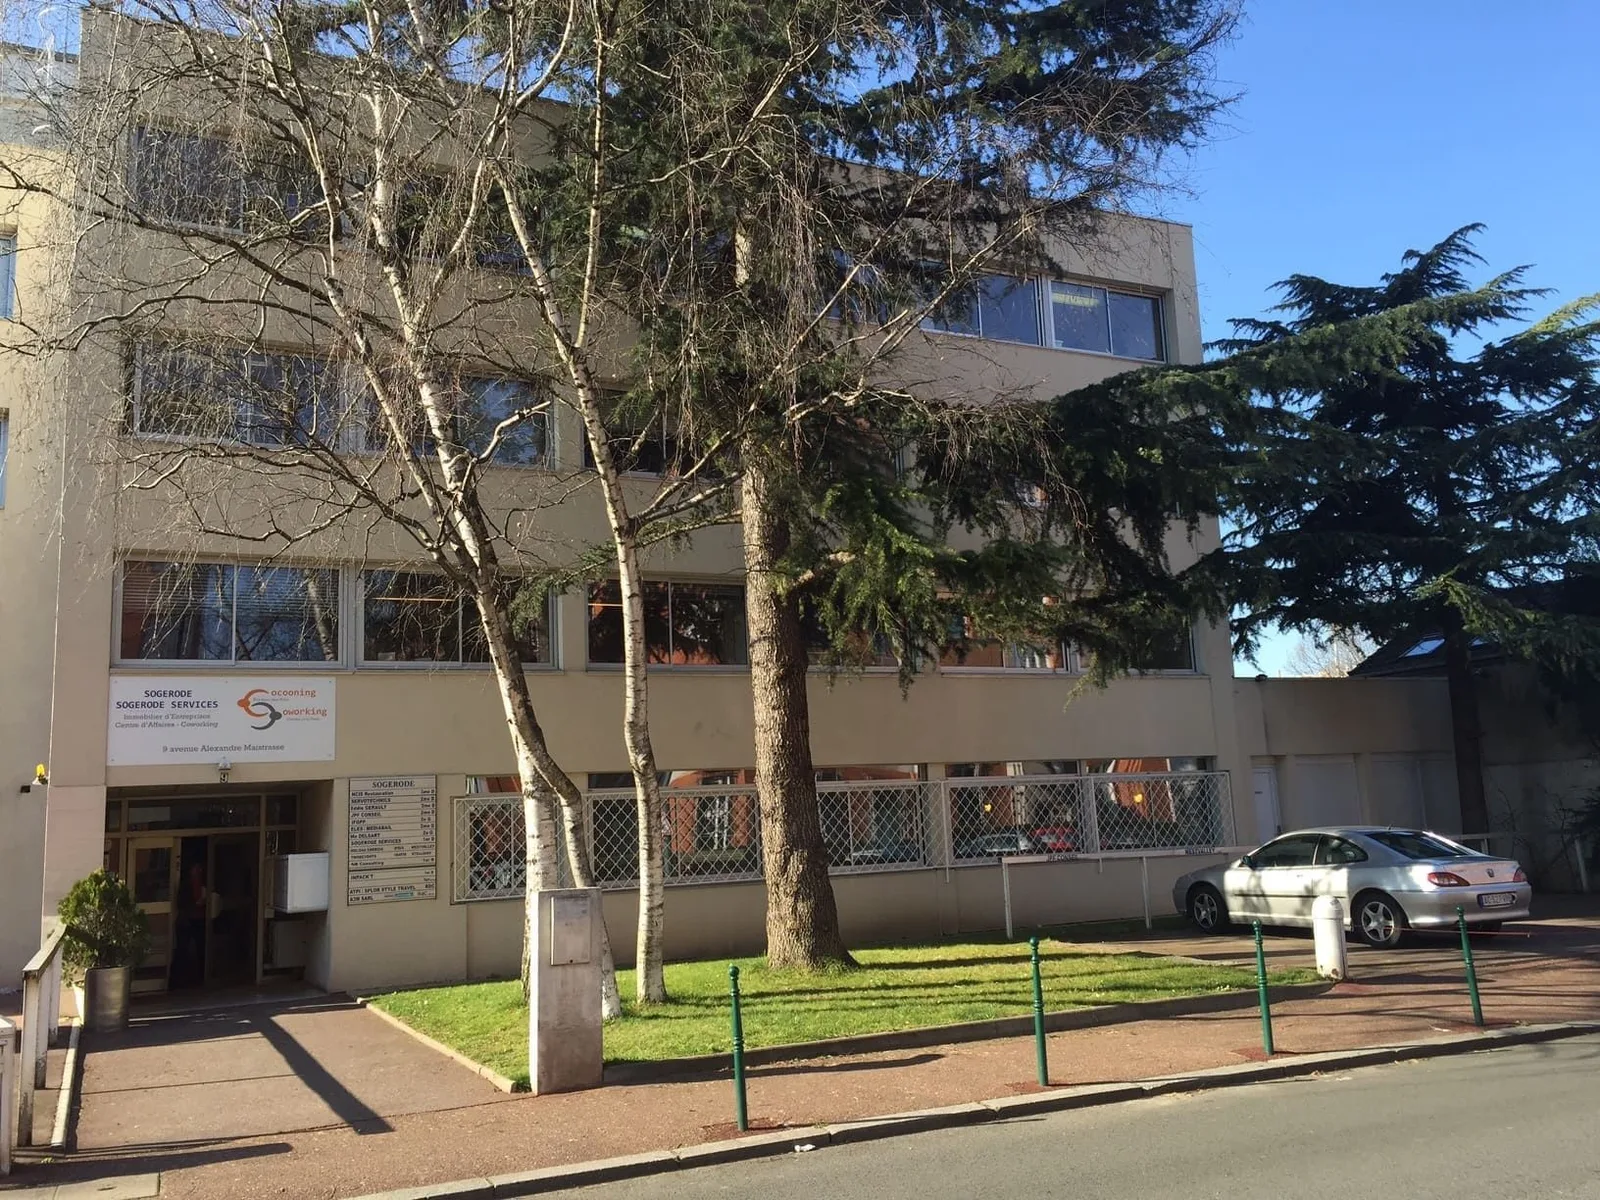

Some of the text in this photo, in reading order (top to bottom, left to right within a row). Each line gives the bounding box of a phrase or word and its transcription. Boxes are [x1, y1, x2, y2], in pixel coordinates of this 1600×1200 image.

[144, 690, 193, 698] SOGERODE
[116, 700, 219, 709] SOGERODE SERVICES
[180, 720, 219, 729] Coworking
[200, 744, 242, 752] Alexandre
[221, 772, 229, 783] 9
[372, 780, 416, 788] SOGERODE
